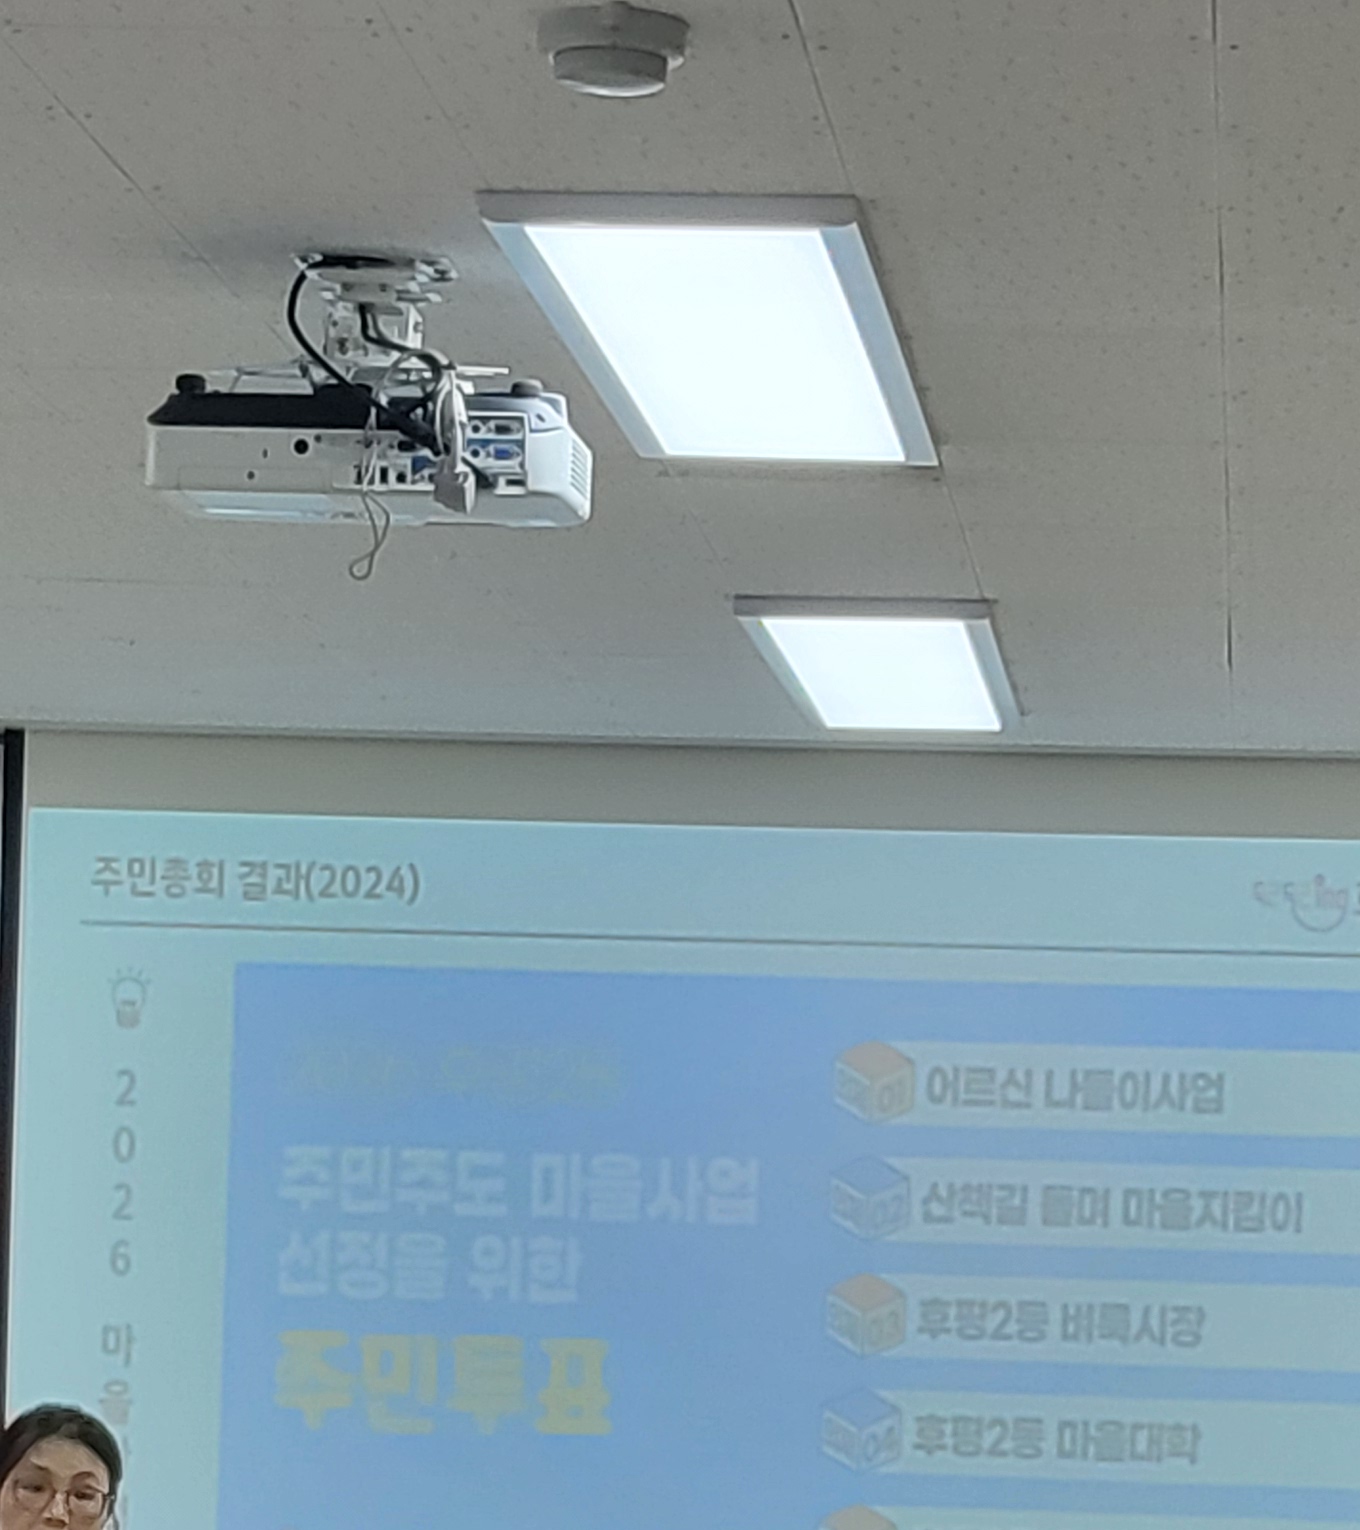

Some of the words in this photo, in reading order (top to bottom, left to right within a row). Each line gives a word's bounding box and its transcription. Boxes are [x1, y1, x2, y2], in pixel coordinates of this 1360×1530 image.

[90, 856, 226, 899] 주민총회
[238, 859, 421, 906] 결과(2024)
[925, 1064, 1033, 1109] 어르신
[1044, 1068, 1226, 1115] 나들이사업
[276, 1144, 509, 1218] 주민주도
[531, 1151, 761, 1226] 마을사업
[921, 1181, 1028, 1227] 산책길
[1121, 1187, 1305, 1234] 마을지킴이
[277, 1228, 447, 1301] 선정을
[468, 1232, 583, 1306] 위한
[916, 1296, 1049, 1344] 후평2동
[1061, 1301, 1207, 1348] 벼룩시장
[274, 1328, 613, 1436] 주민투표
[912, 1413, 1046, 1461] 후평2동
[1056, 1420, 1203, 1465] 마을대학
